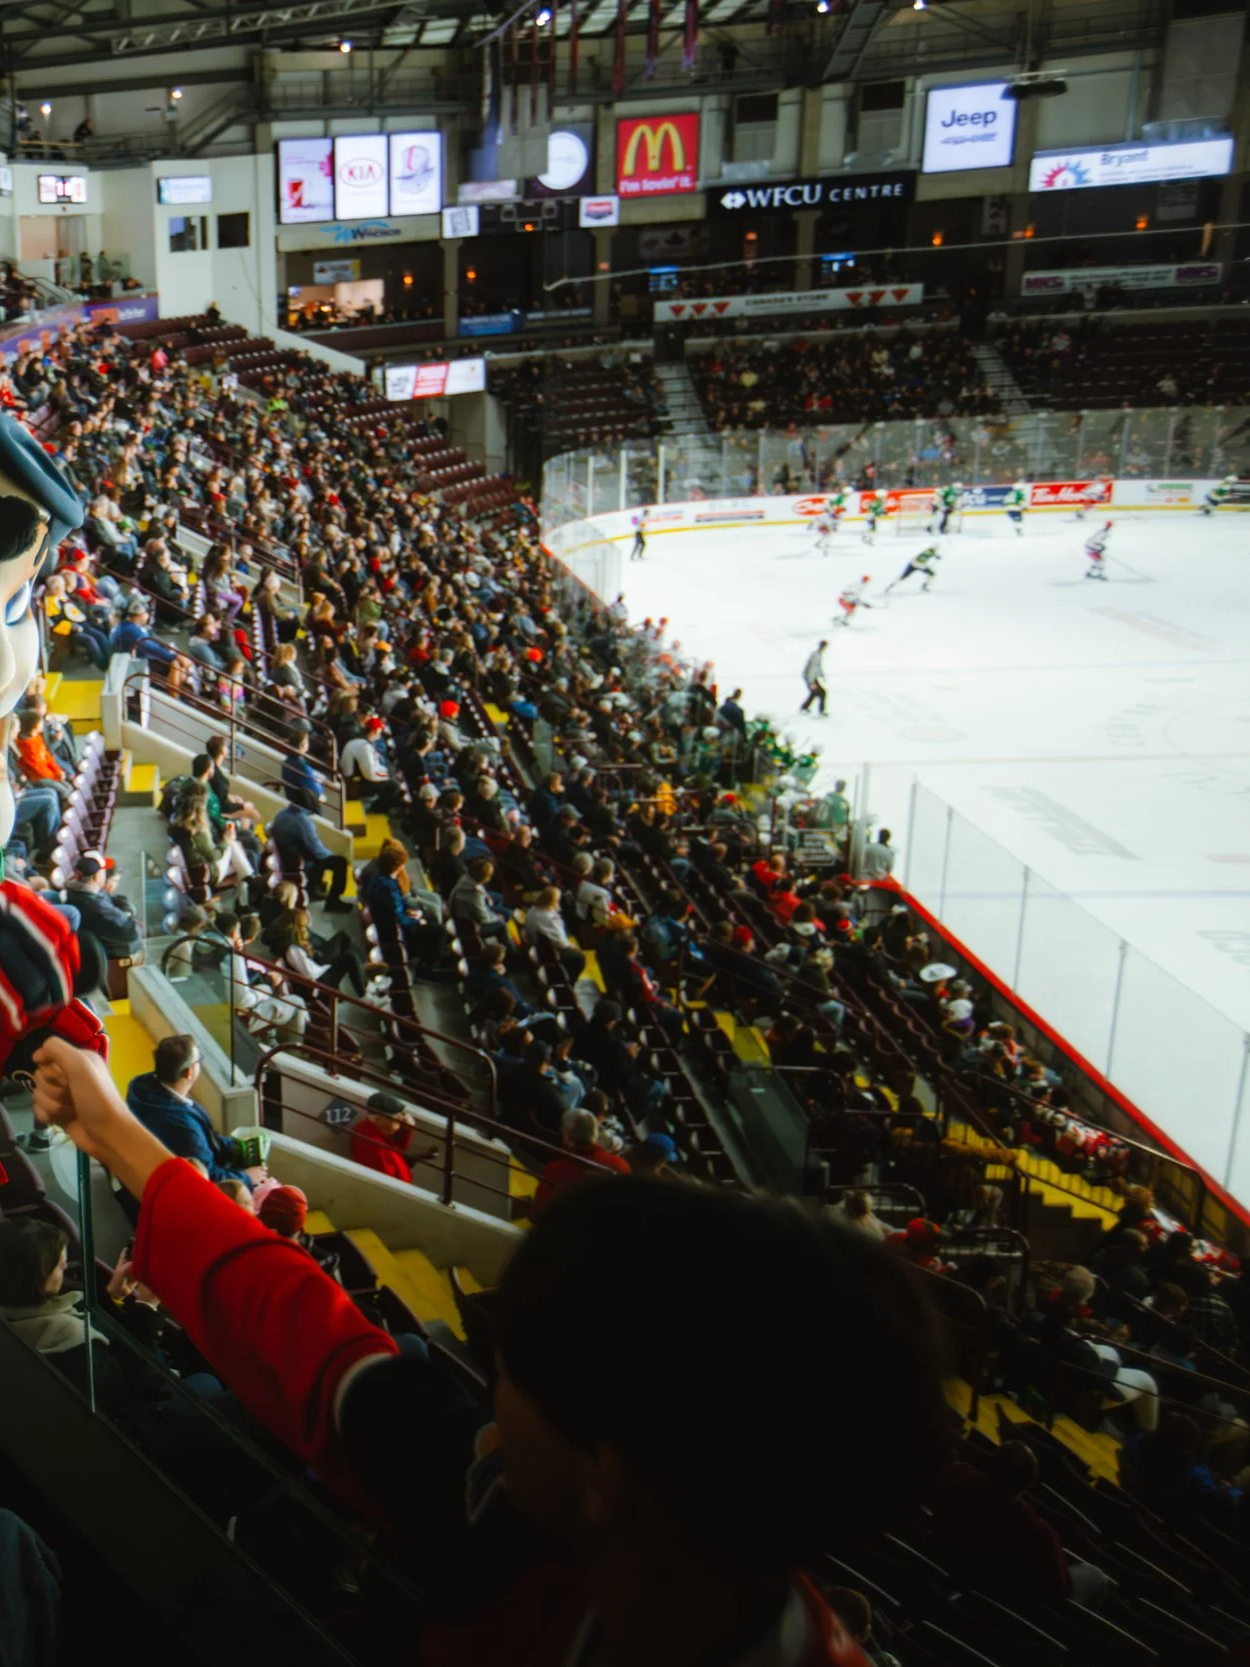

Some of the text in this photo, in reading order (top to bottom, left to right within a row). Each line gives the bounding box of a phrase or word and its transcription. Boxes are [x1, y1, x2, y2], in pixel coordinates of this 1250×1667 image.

[941, 109, 998, 128] Jeep
[348, 163, 376, 182] KIA
[746, 183, 905, 209] WFCU CENTRE
[326, 1107, 352, 1124] 112
